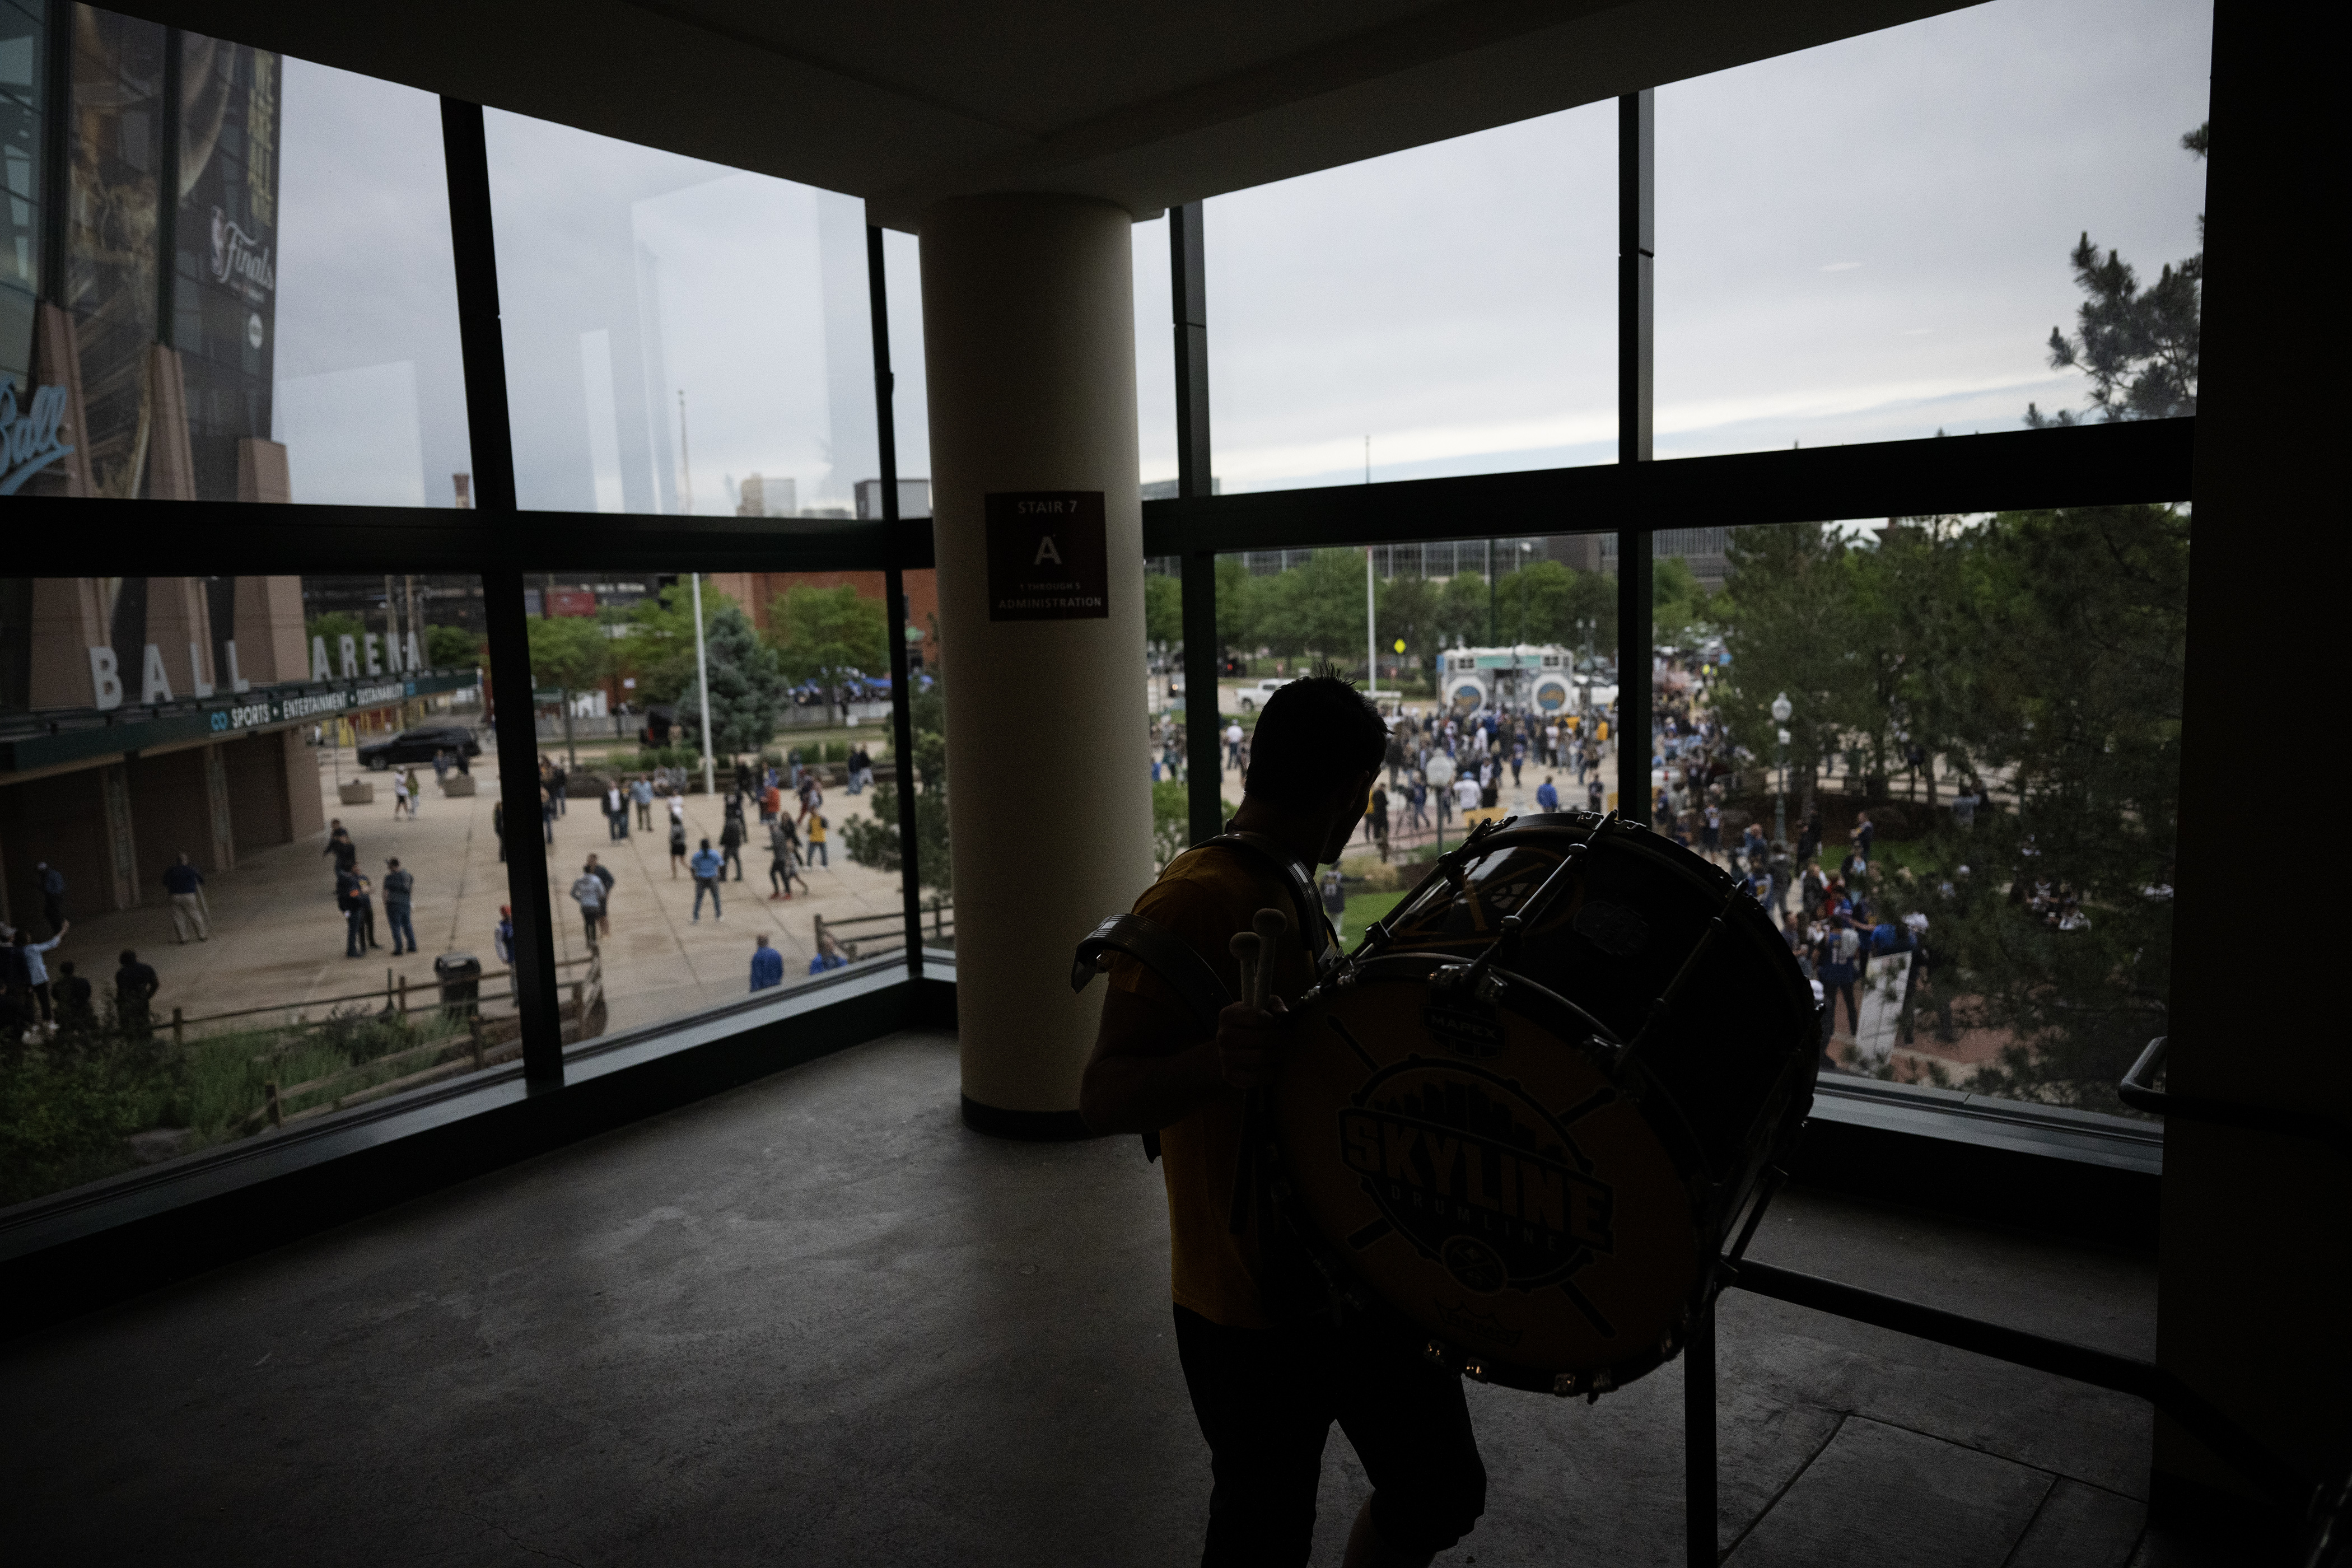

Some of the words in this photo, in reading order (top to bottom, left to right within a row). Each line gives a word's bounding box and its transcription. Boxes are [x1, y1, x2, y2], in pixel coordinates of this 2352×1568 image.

[1018, 501, 1063, 515] STAIR
[1068, 500, 1077, 514] 7
[1033, 536, 1062, 566] A
[1026, 582, 1073, 591] THROUGH
[998, 596, 1102, 609] ADMINISTRATION
[89, 640, 250, 711] BALL
[312, 631, 422, 683] ARENA
[231, 703, 270, 729] SPORTS
[282, 690, 348, 720] ENTERTAINMENT
[1430, 1014, 1497, 1040] MAPEX
[1345, 1114, 1607, 1247] SKYLINE
[1390, 1184, 1557, 1253] DRUMLINE
